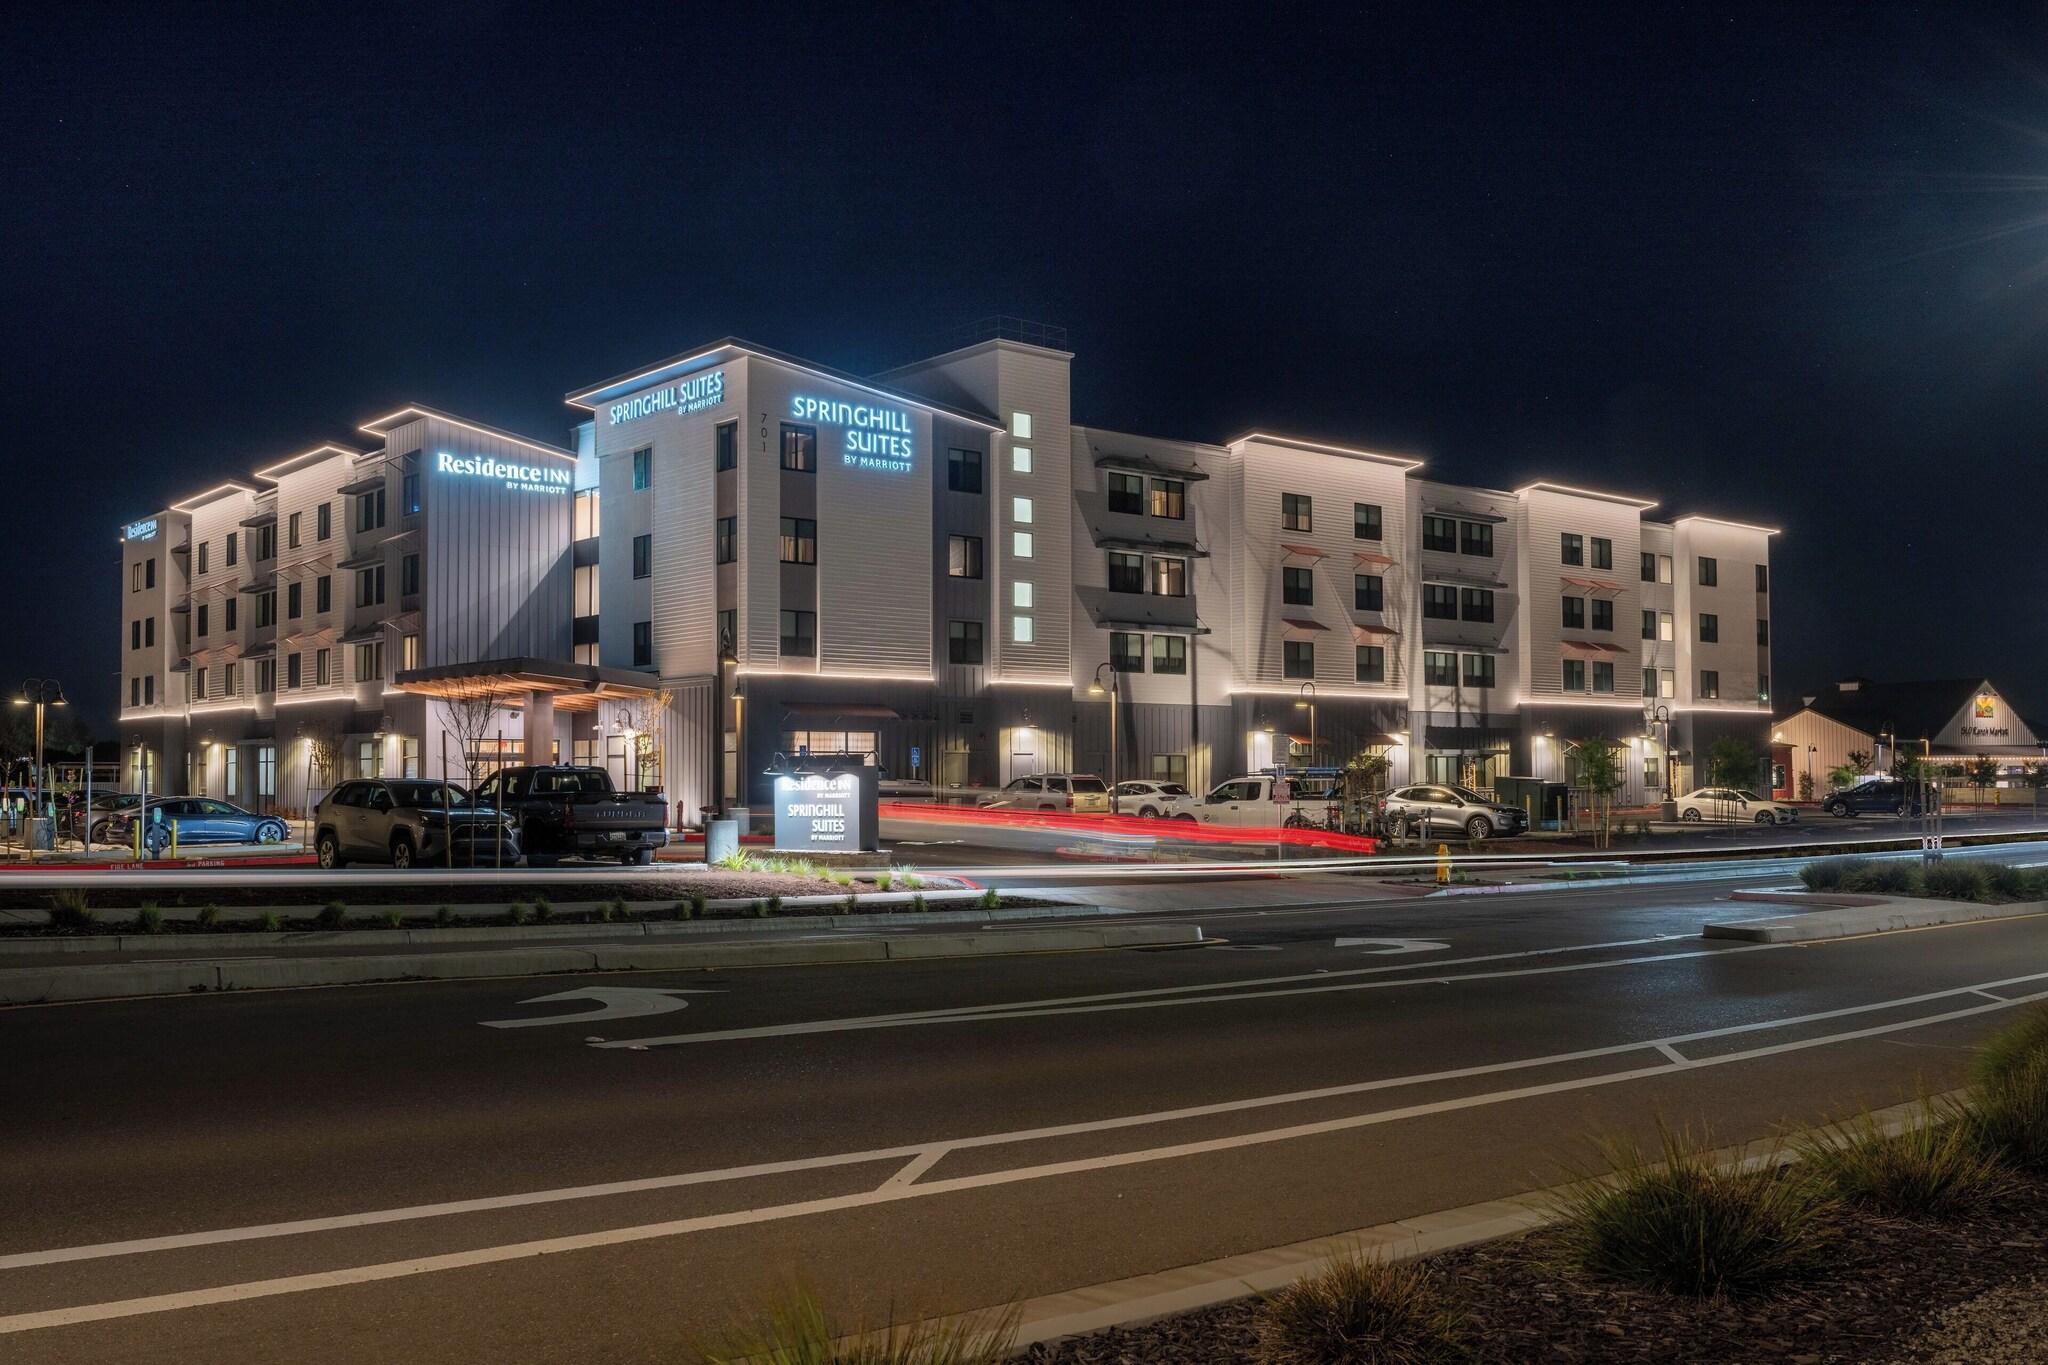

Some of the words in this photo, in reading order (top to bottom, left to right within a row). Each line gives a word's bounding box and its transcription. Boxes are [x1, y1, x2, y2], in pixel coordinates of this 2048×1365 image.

[610, 387, 677, 424] SPRINGHILL
[680, 372, 722, 402] SUITES
[678, 406, 687, 415] BY
[688, 394, 721, 412] MARRIOTT
[793, 396, 912, 433] SPRINGHILL
[847, 430, 912, 457] SUITES
[438, 452, 541, 481] Residence
[544, 467, 570, 484] INN
[844, 455, 857, 464] BY
[861, 457, 912, 472] MARRIOTT
[506, 481, 518, 489] BY
[521, 482, 566, 494] MARRIOTT
[781, 777, 836, 791] esidnce
[788, 804, 845, 817] SPRINGHILL
[812, 819, 845, 832] SUITES
